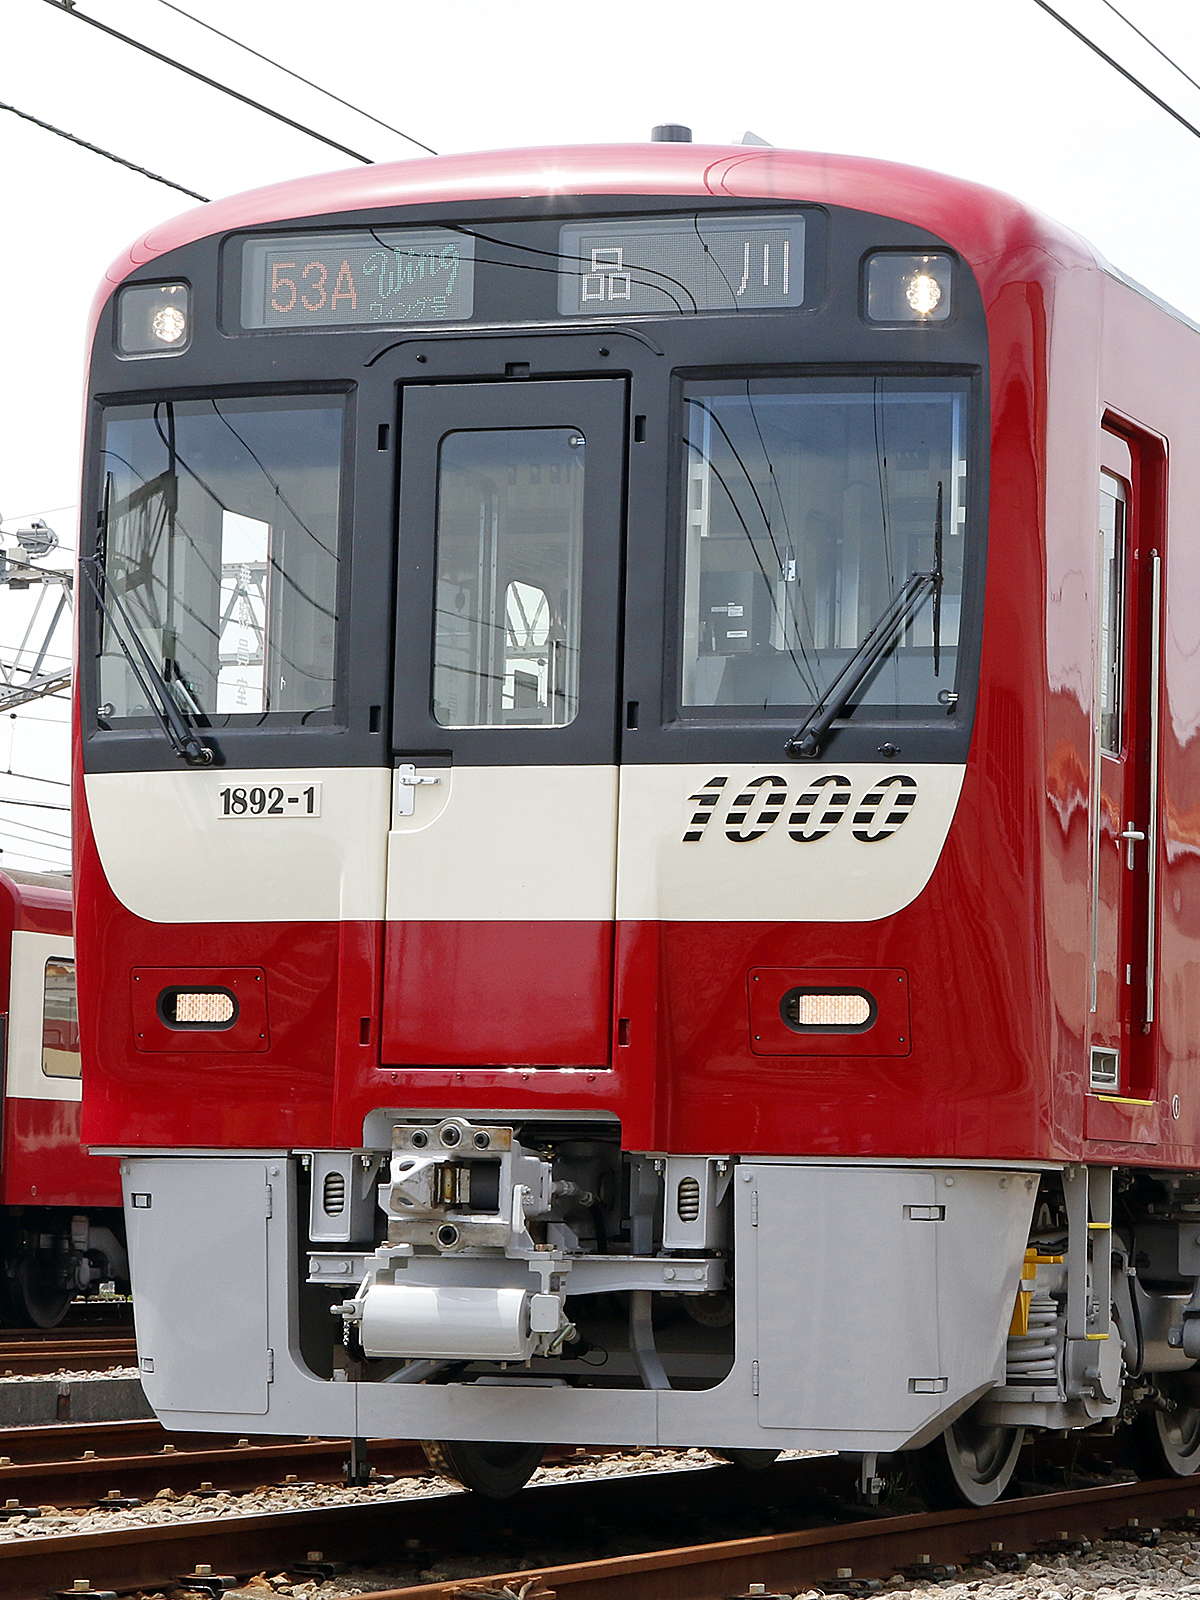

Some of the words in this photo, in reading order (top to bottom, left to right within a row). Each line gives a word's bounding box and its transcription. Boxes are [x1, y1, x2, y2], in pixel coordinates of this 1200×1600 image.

[271, 259, 357, 312] 53A
[361, 243, 460, 298] Wing
[582, 239, 789, 301] 品川
[220, 786, 315, 815] 1892-1
[682, 775, 918, 842] 1000
